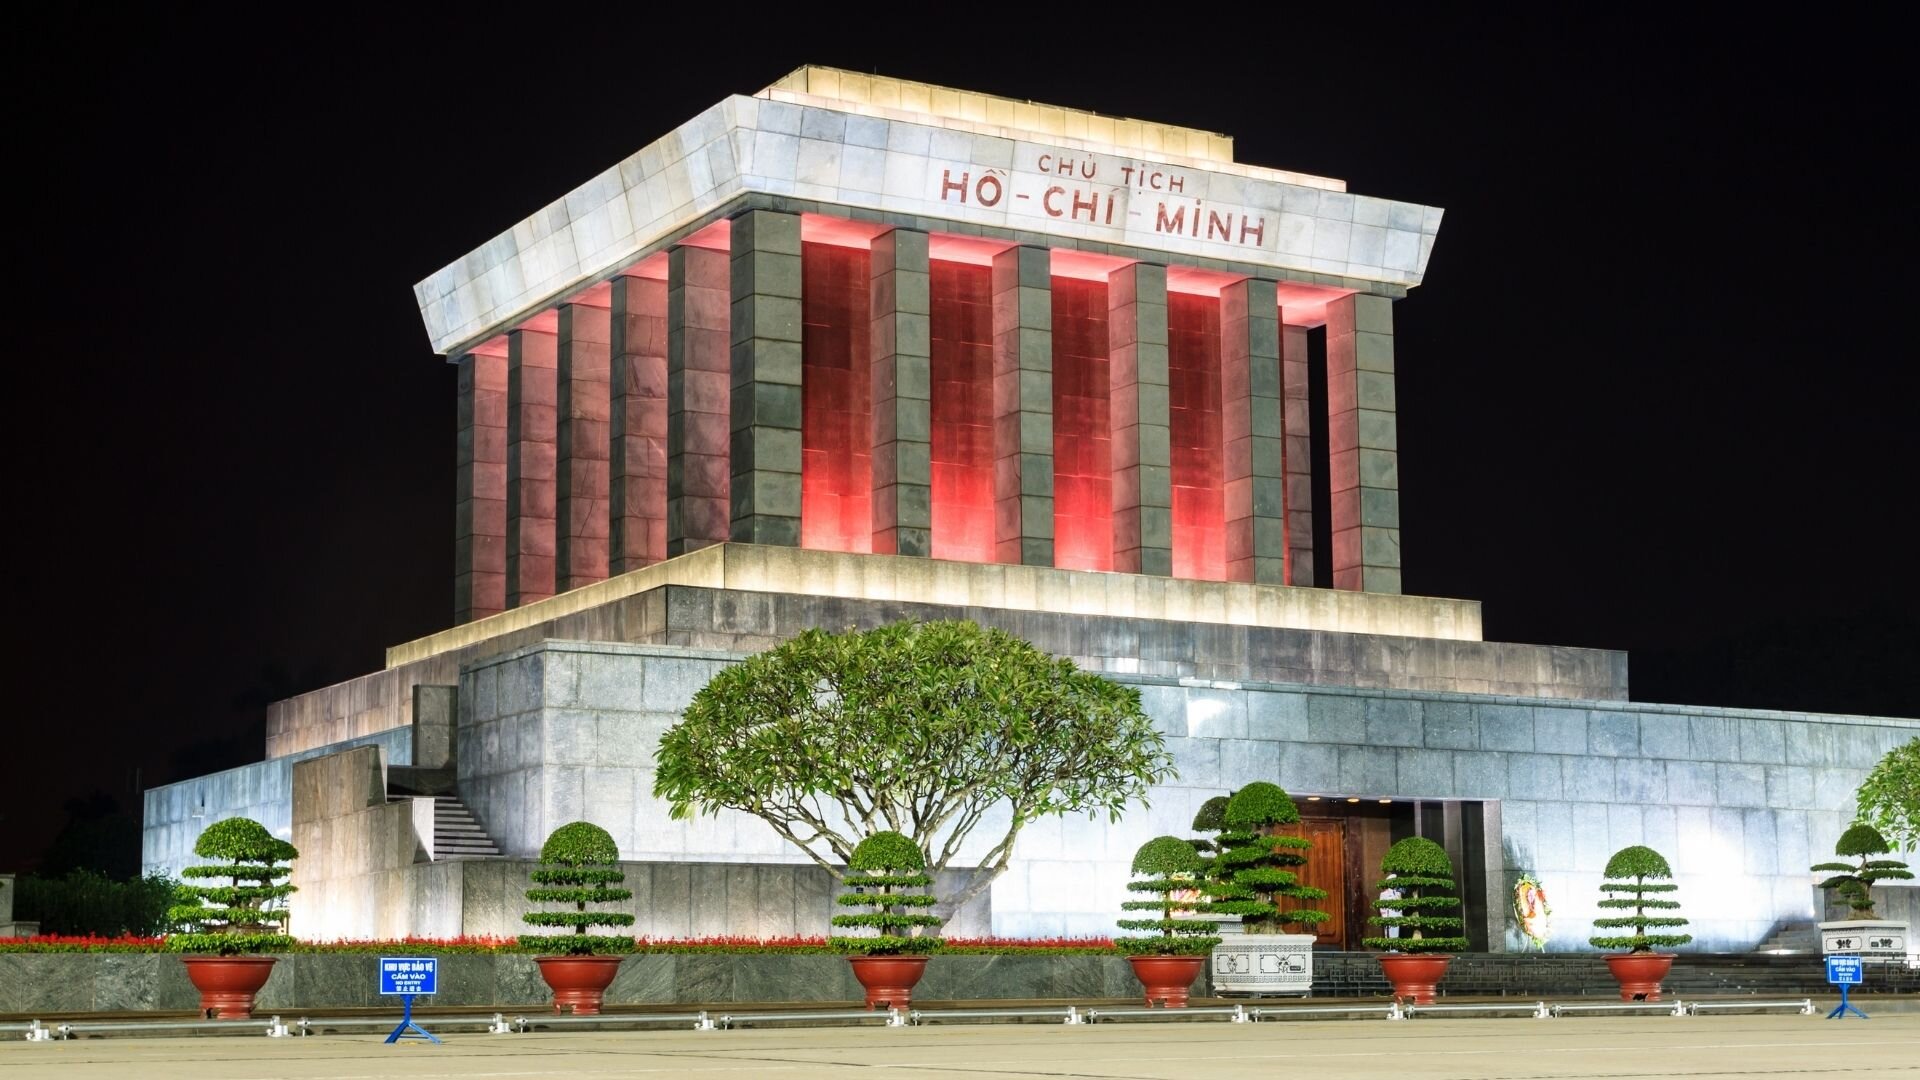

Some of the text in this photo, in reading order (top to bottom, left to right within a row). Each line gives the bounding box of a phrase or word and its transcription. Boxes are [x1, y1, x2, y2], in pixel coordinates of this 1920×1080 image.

[1039, 153, 1096, 179] CHỦ
[941, 168, 1007, 208] HỒ
[1043, 187, 1120, 225] CHÍ
